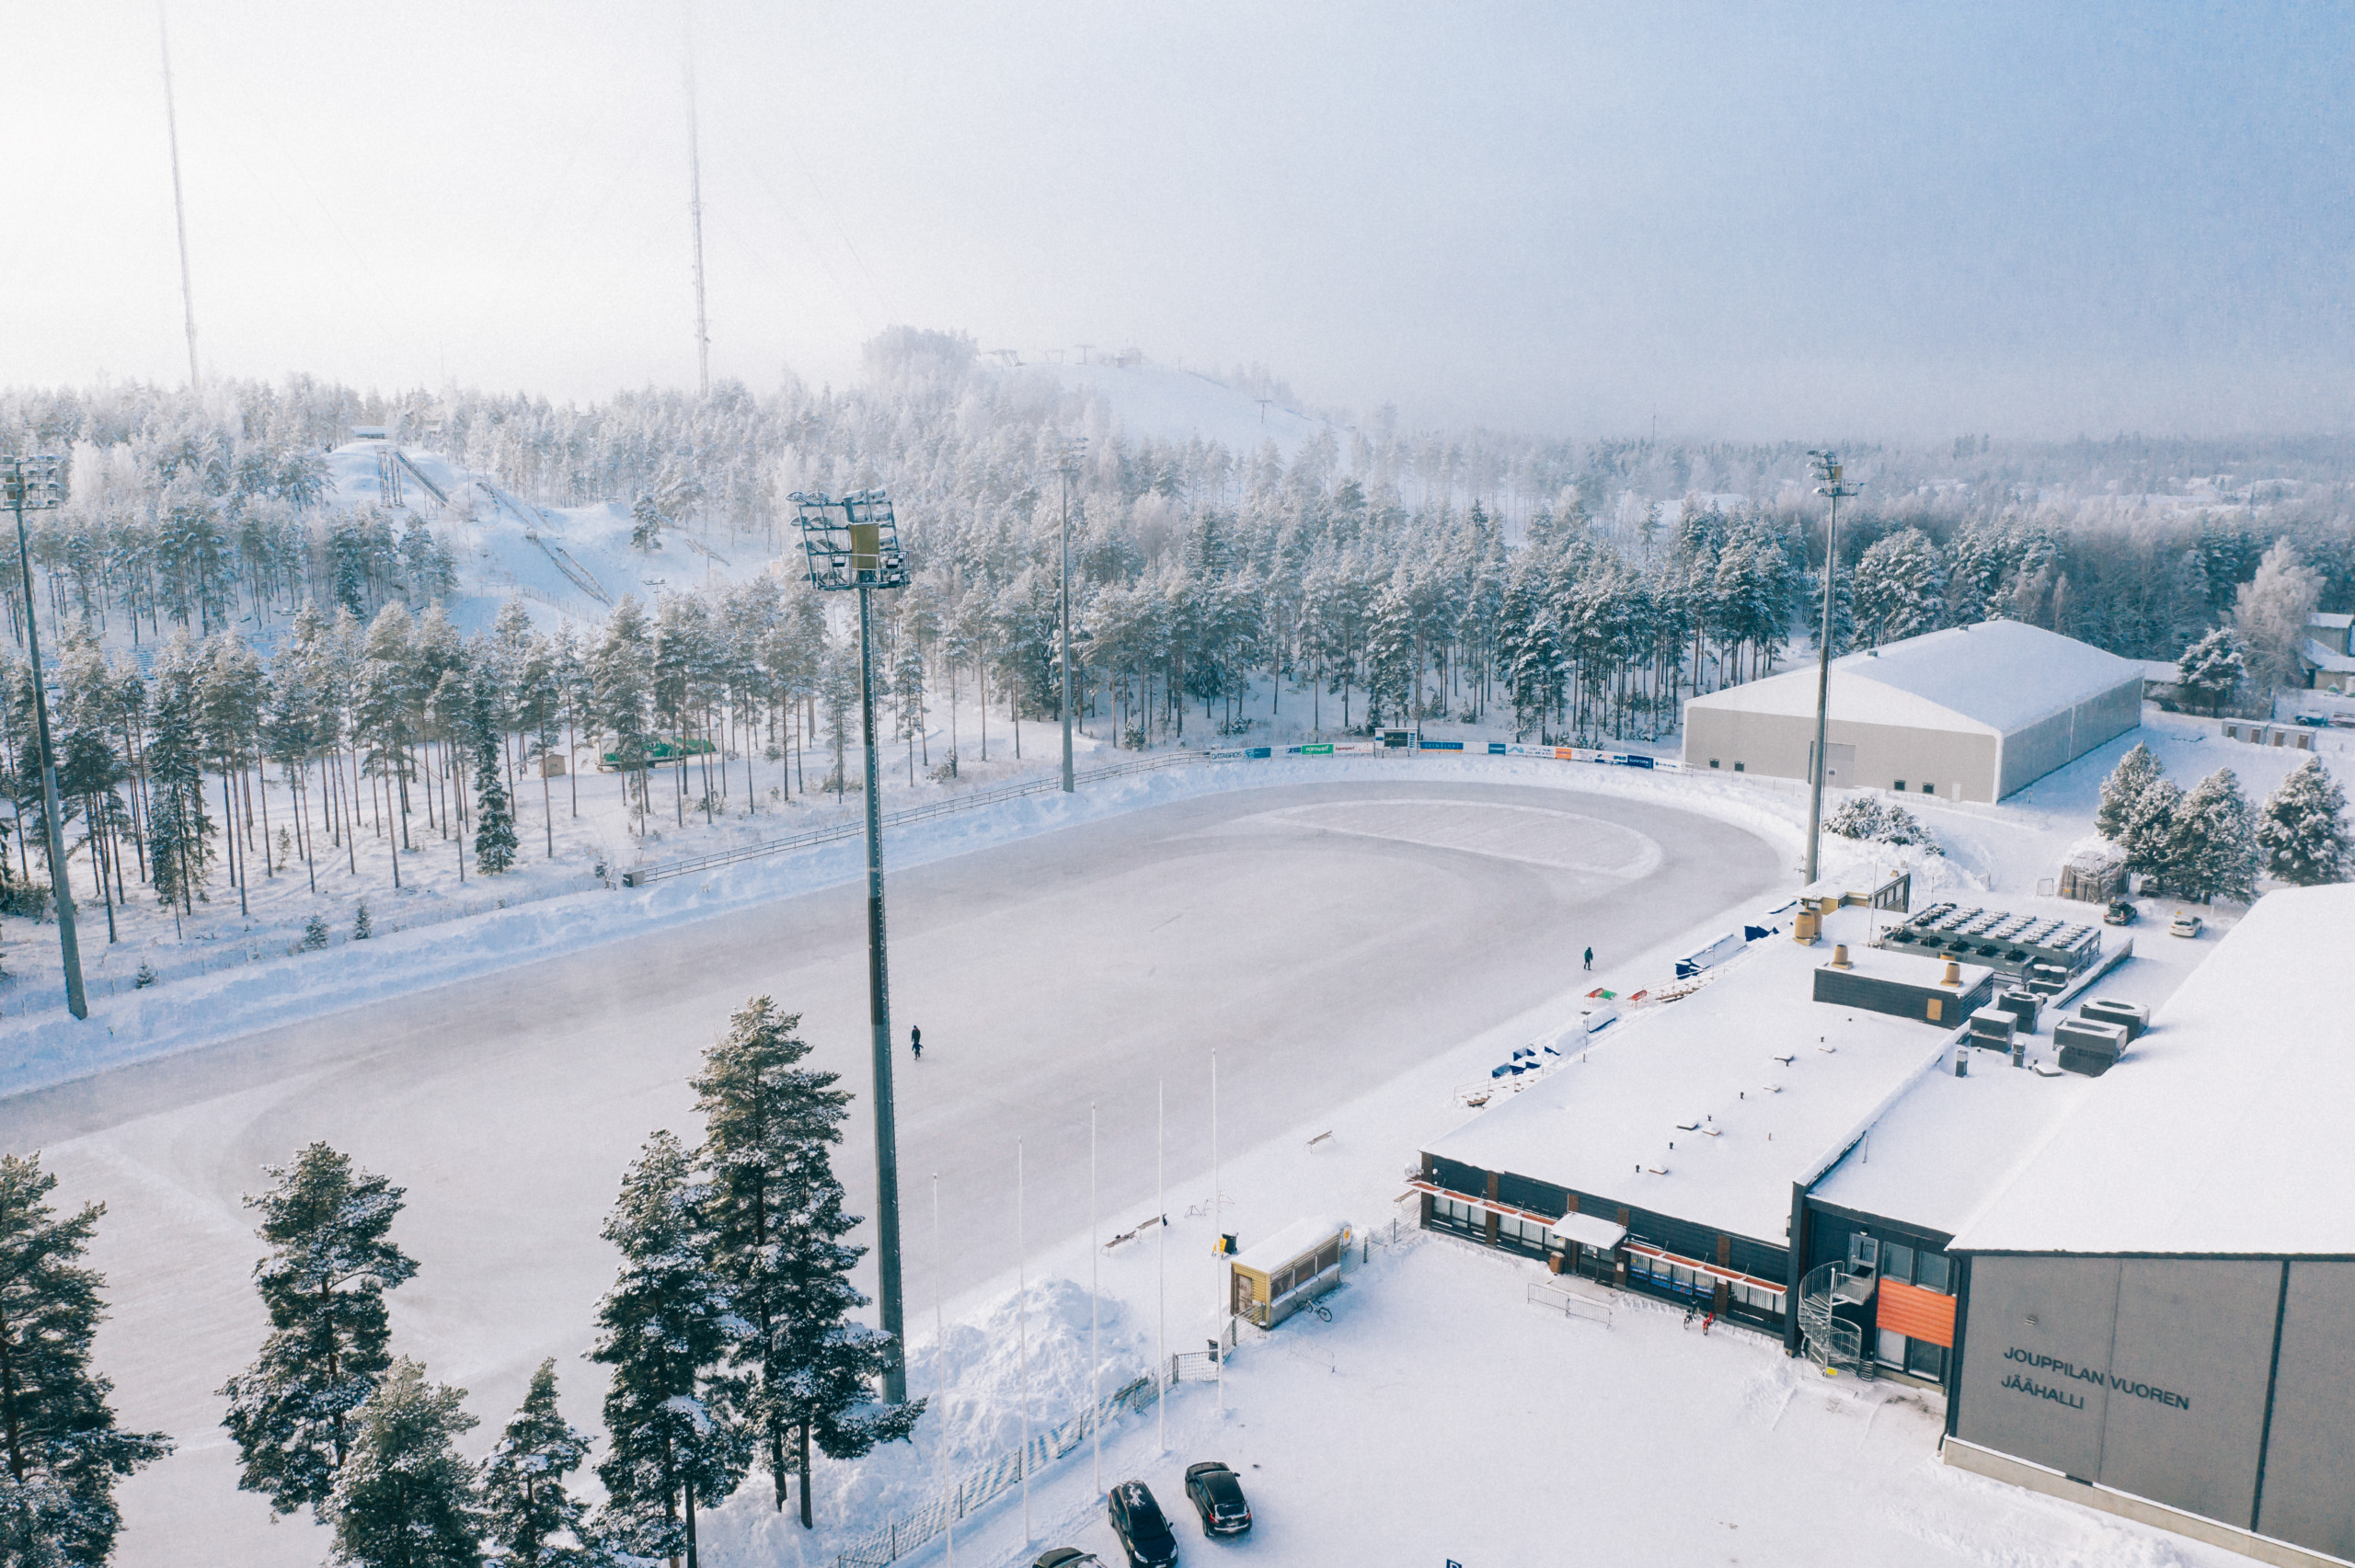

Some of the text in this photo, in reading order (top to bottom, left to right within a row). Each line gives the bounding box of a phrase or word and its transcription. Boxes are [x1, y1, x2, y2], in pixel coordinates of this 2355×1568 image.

[2001, 1375, 2085, 1410] JÄÄHALLI
[2004, 1346, 2190, 1410] JOUPPILAN VUOREN
